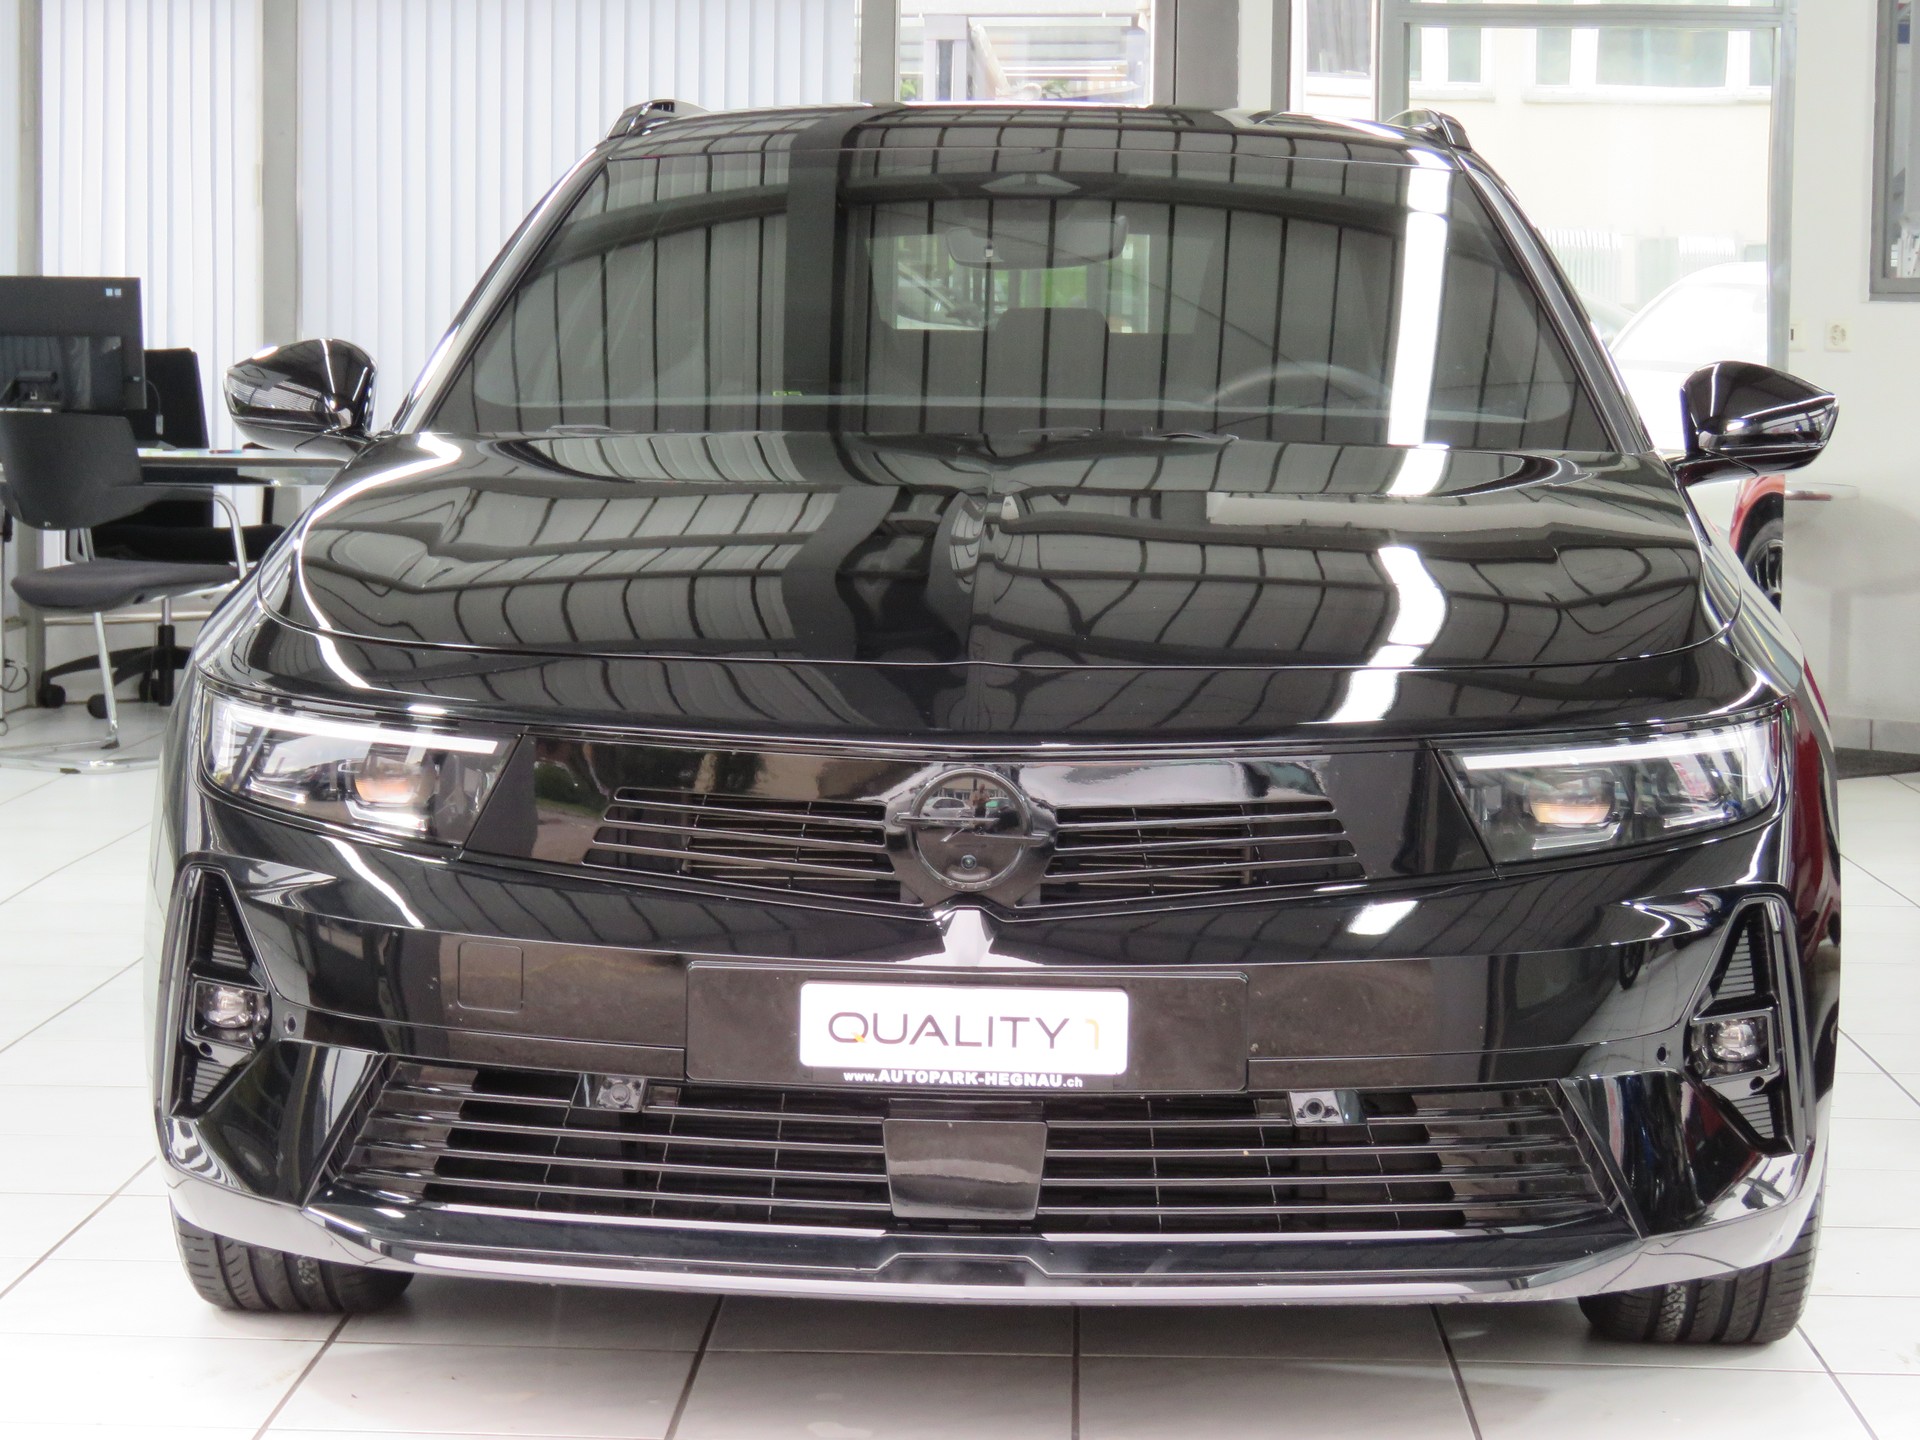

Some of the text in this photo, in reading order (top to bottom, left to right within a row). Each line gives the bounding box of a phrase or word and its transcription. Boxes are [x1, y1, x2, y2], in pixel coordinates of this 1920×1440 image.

[828, 1011, 1100, 1051] QUALITY 1
[843, 1069, 1083, 1089] www.AUTOPARK-HEGNAU.ch
